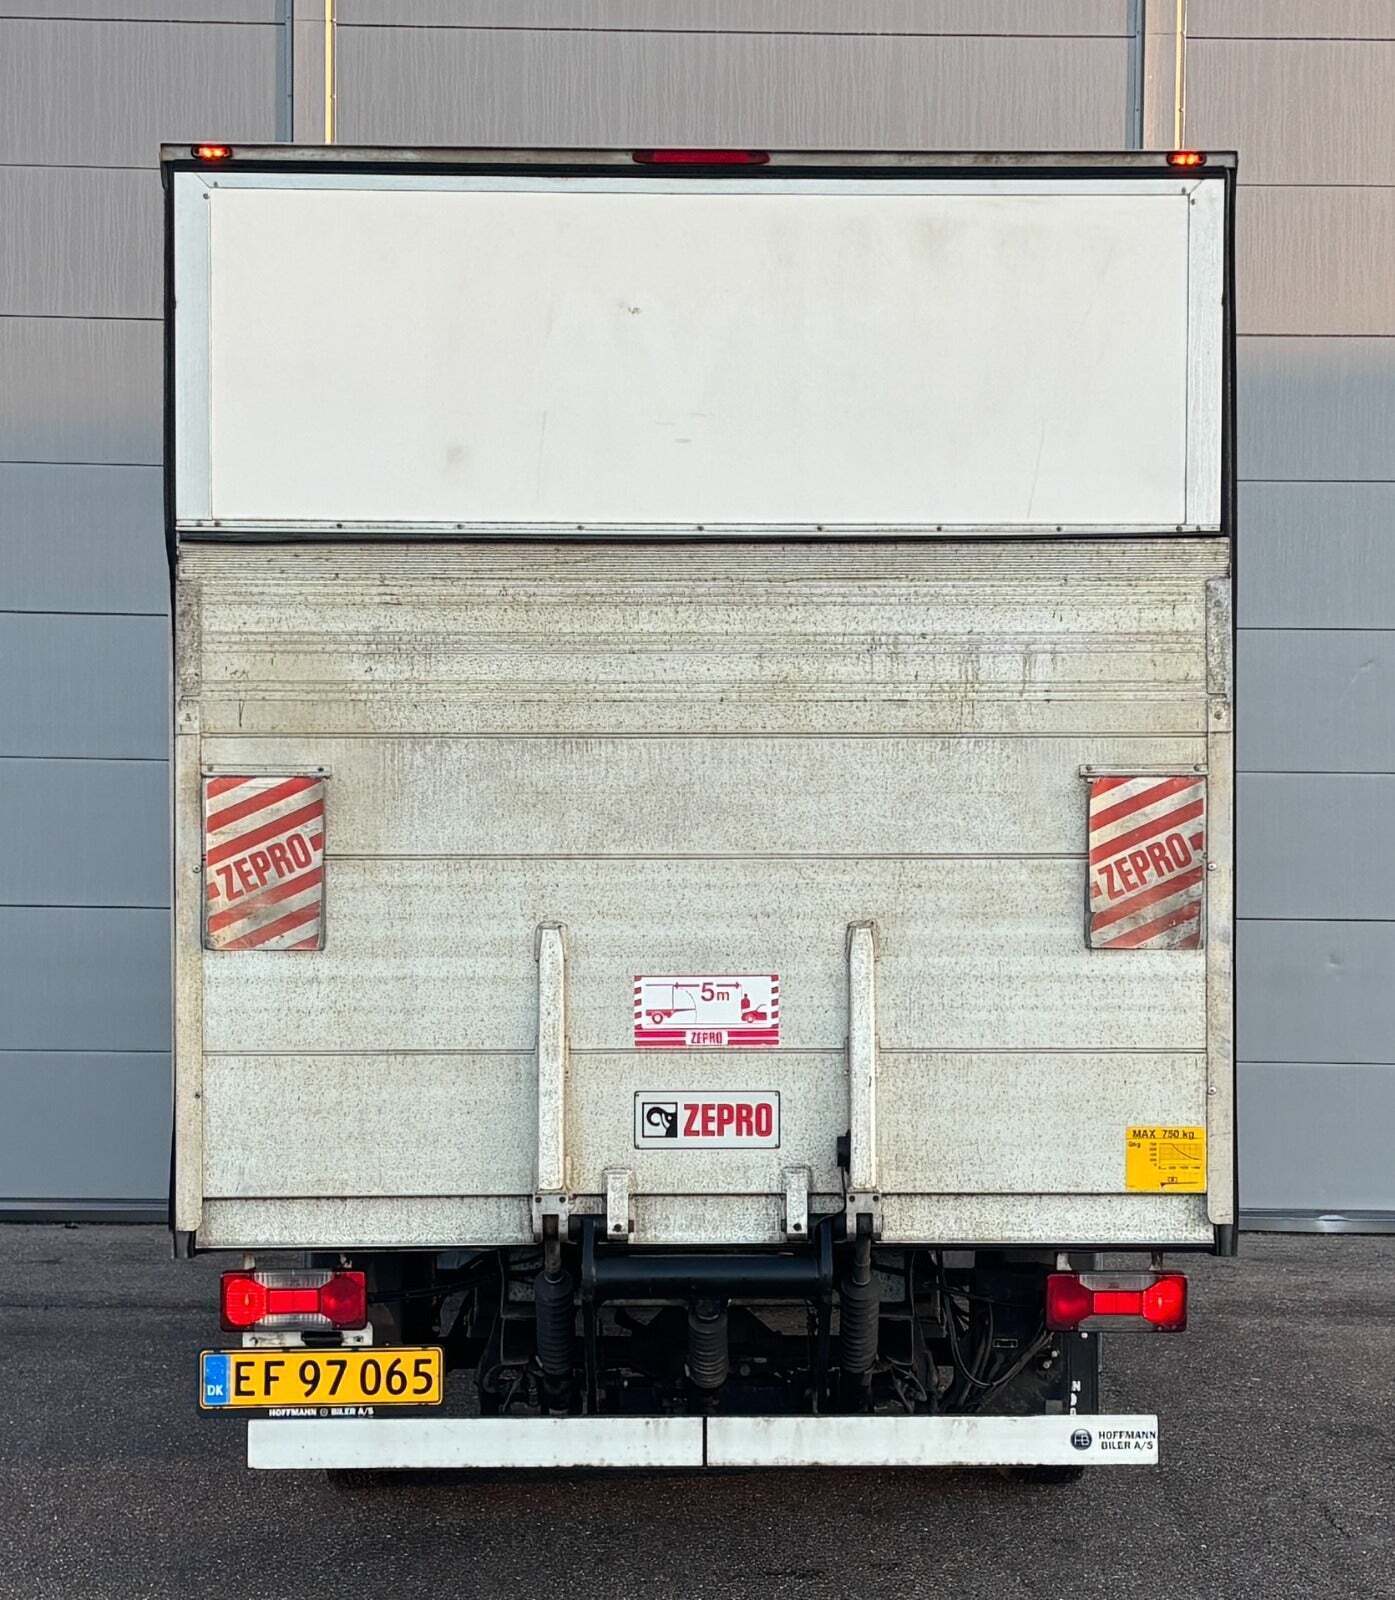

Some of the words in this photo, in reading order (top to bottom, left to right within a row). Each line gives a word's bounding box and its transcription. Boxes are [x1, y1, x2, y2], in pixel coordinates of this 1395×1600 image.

[216, 833, 312, 901] ZEPRO
[1098, 833, 1193, 900] ZEPRO
[691, 1032, 723, 1044] ZEPRO
[683, 1103, 773, 1137] ZEPRO
[1132, 1129, 1156, 1139] MAX
[1161, 1129, 1180, 1139] 750
[1182, 1129, 1195, 1140] kg
[207, 1384, 224, 1396] DK
[268, 1408, 317, 1416] HOFFMANN
[331, 1407, 356, 1415] BILER
[357, 1407, 374, 1416] A/S
[1098, 1430, 1156, 1439] HOFFMANN
[1101, 1441, 1131, 1449] BILER
[1134, 1440, 1154, 1450] A/S
